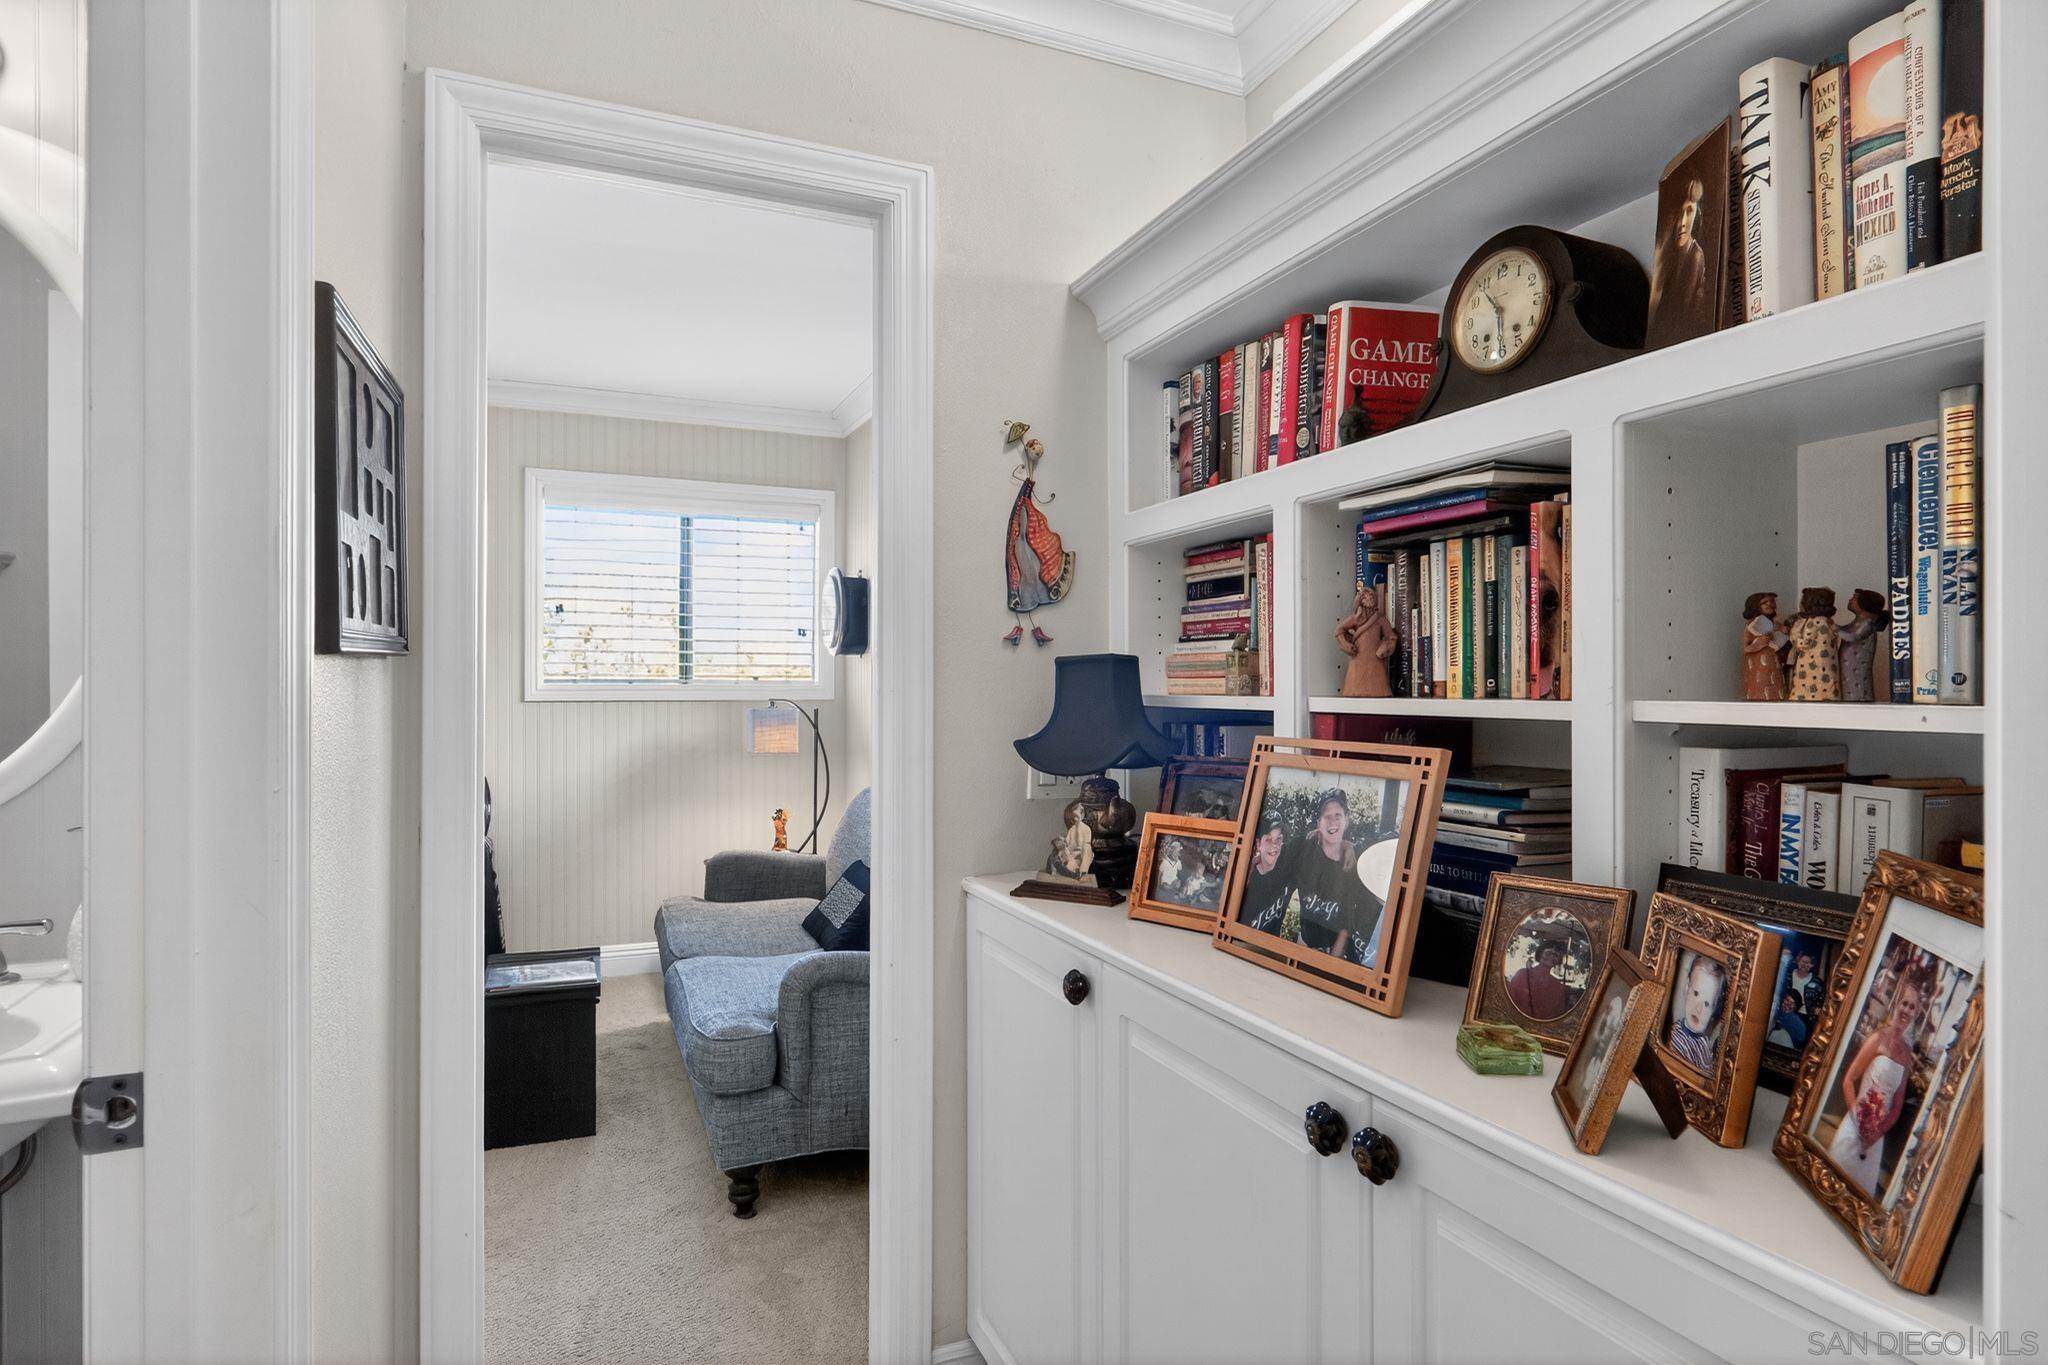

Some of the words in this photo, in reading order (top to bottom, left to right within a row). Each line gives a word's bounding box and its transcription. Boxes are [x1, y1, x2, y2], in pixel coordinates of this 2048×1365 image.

[1814, 81, 1837, 99] AMY
[1815, 97, 1837, 114] TAN
[1740, 77, 1772, 198] TALK
[1497, 262, 1509, 281] 12
[1517, 264, 1522, 277] 1
[1528, 273, 1537, 287] 2
[1471, 296, 1480, 310] 10
[1533, 291, 1543, 306] 3
[1466, 318, 1474, 330] 9
[1527, 315, 1536, 328] 4
[1472, 335, 1479, 349] 8
[1514, 333, 1523, 348] 5
[1350, 337, 1433, 365] GAME
[1482, 346, 1490, 361] 7
[1499, 345, 1507, 358] 6
[1297, 335, 1312, 426] LINDBERGH
[1946, 410, 1974, 491] MIRACLE
[1917, 442, 1939, 552] Clemente!
[1946, 502, 1974, 540] MAN
[1942, 550, 1958, 605] RYAN
[1891, 576, 1911, 660] PADRES
[1686, 769, 1705, 829] Treasury
[1781, 813, 1801, 835] IN
[1780, 835, 1800, 867] MY
